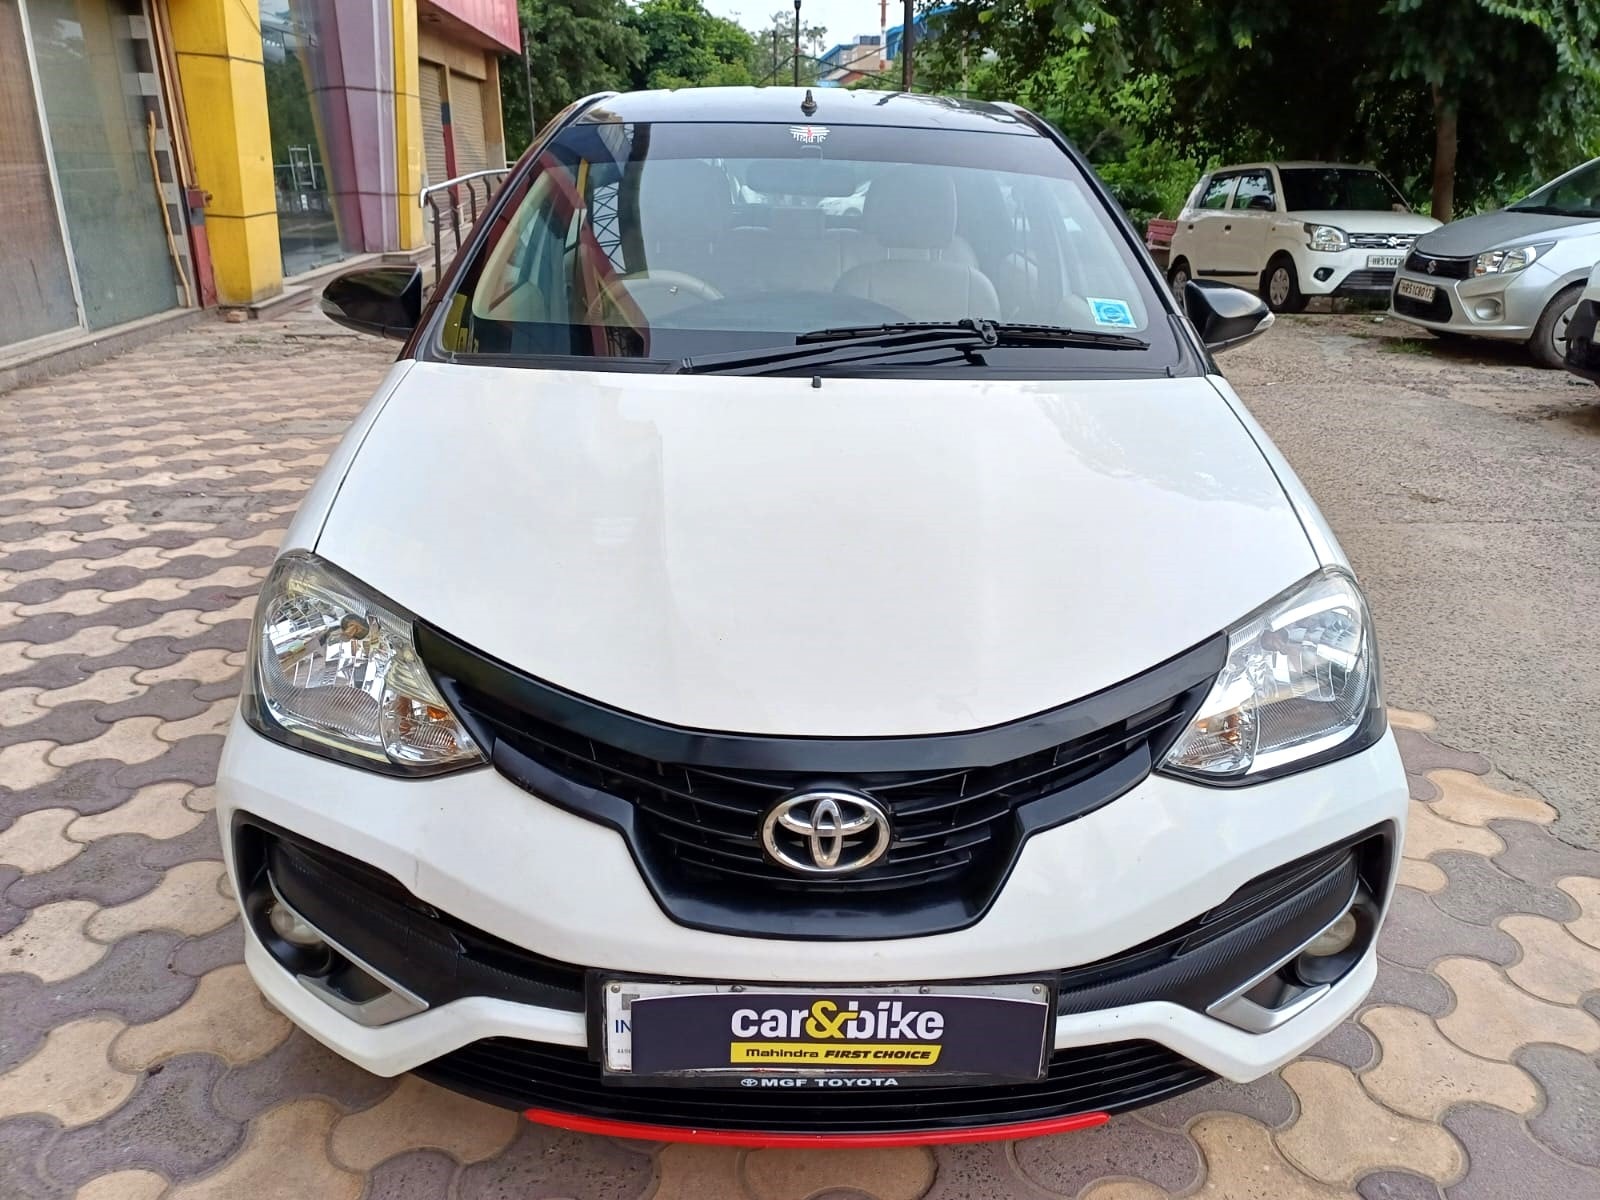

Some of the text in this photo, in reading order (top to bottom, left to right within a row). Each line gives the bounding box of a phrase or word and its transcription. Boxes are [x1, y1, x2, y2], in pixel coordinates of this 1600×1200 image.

[731, 1000, 944, 1039] car&bike
[746, 1048, 931, 1059] Mahindra FIRST CHOICE
[761, 1078, 899, 1087] MGF TOYOTA
